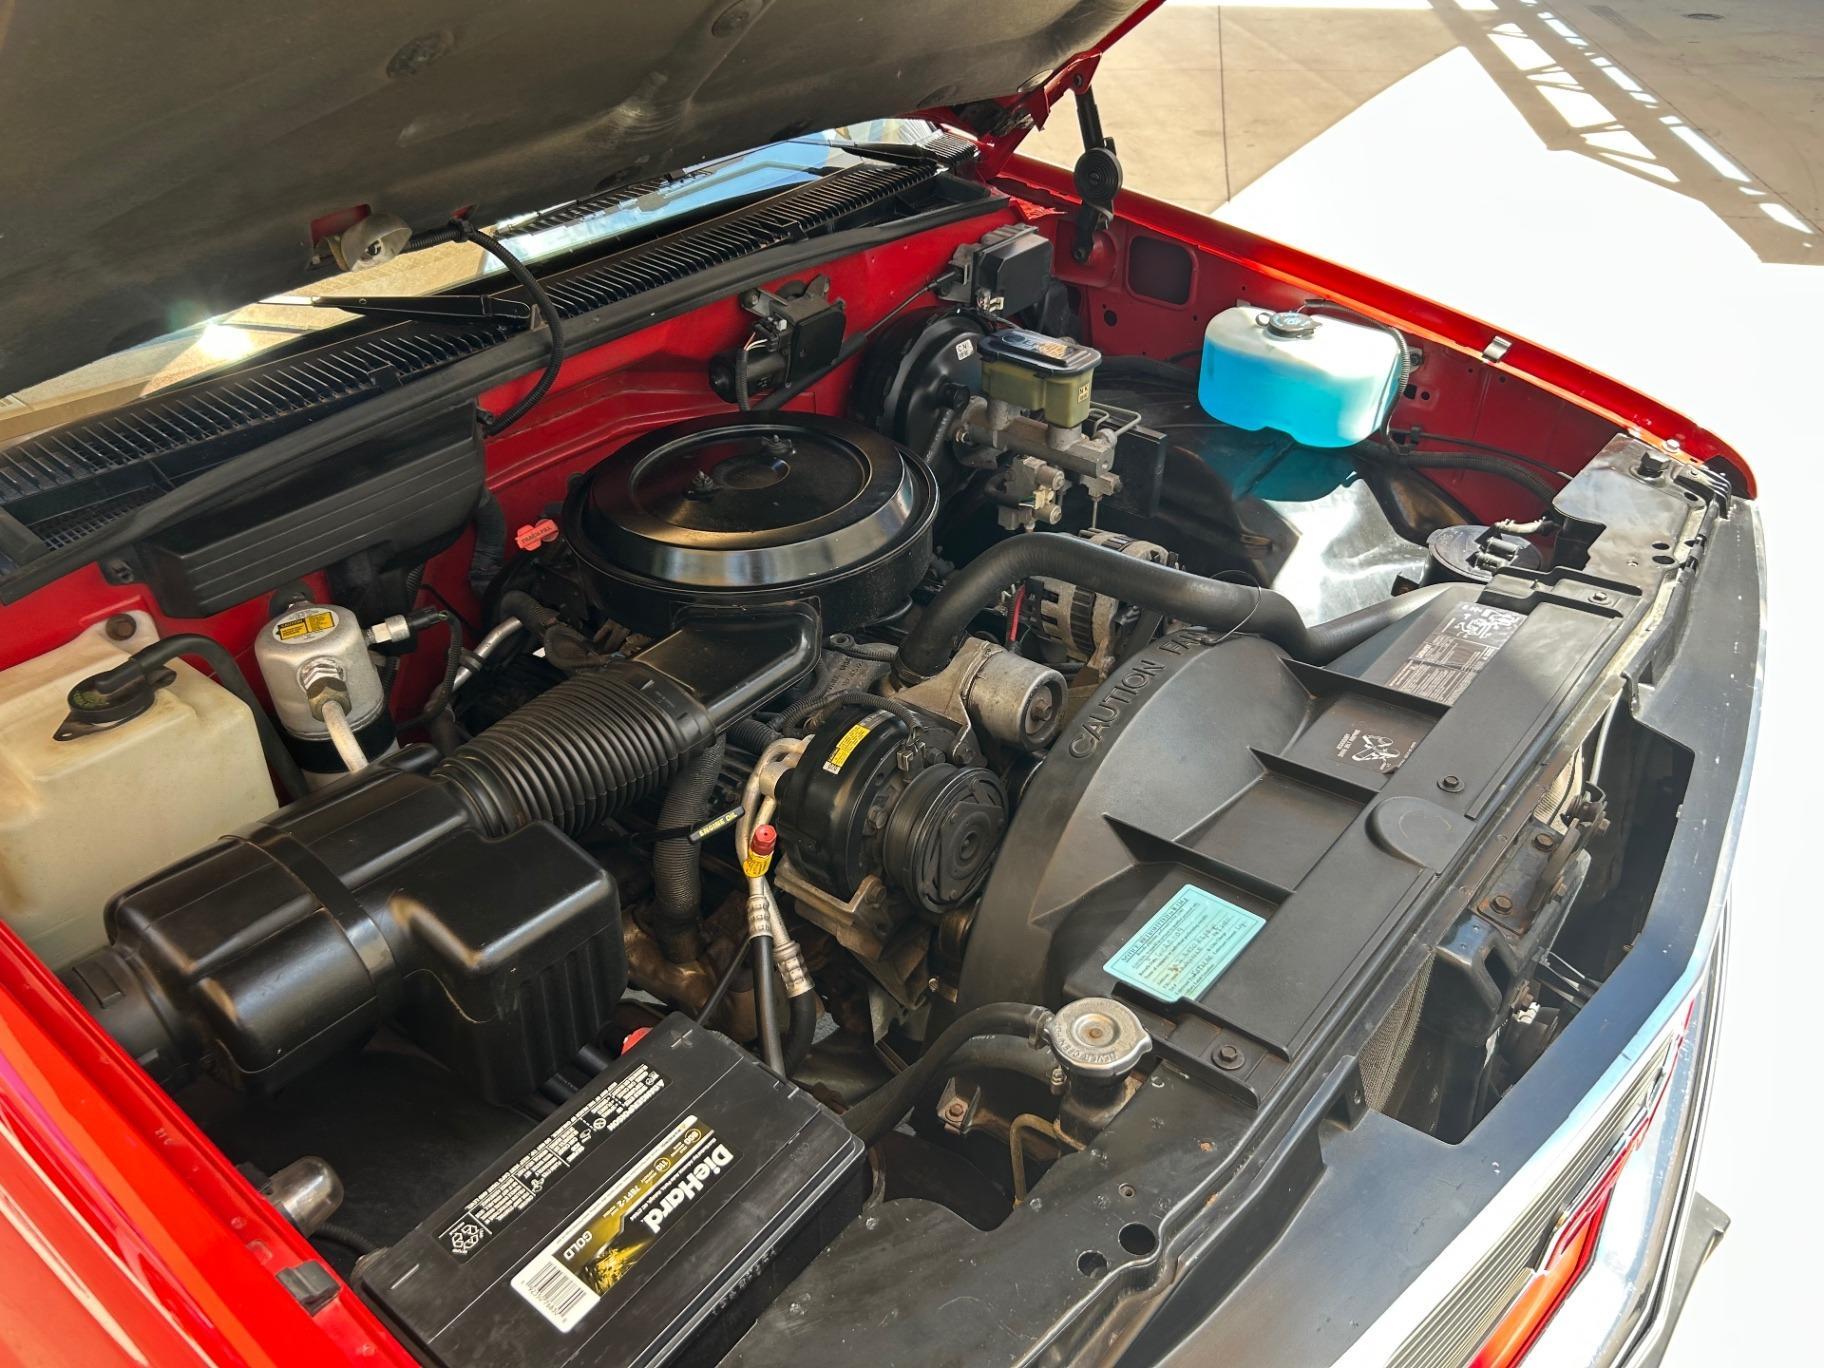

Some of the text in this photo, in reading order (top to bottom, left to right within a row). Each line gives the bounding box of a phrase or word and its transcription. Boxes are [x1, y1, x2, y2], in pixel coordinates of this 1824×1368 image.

[1069, 660, 1166, 758] CAUTION
[698, 811, 737, 836] ENGINE OIL
[655, 1159, 668, 1171] 110
[646, 1144, 734, 1233] DieHard
[563, 1230, 593, 1261] GOLD
